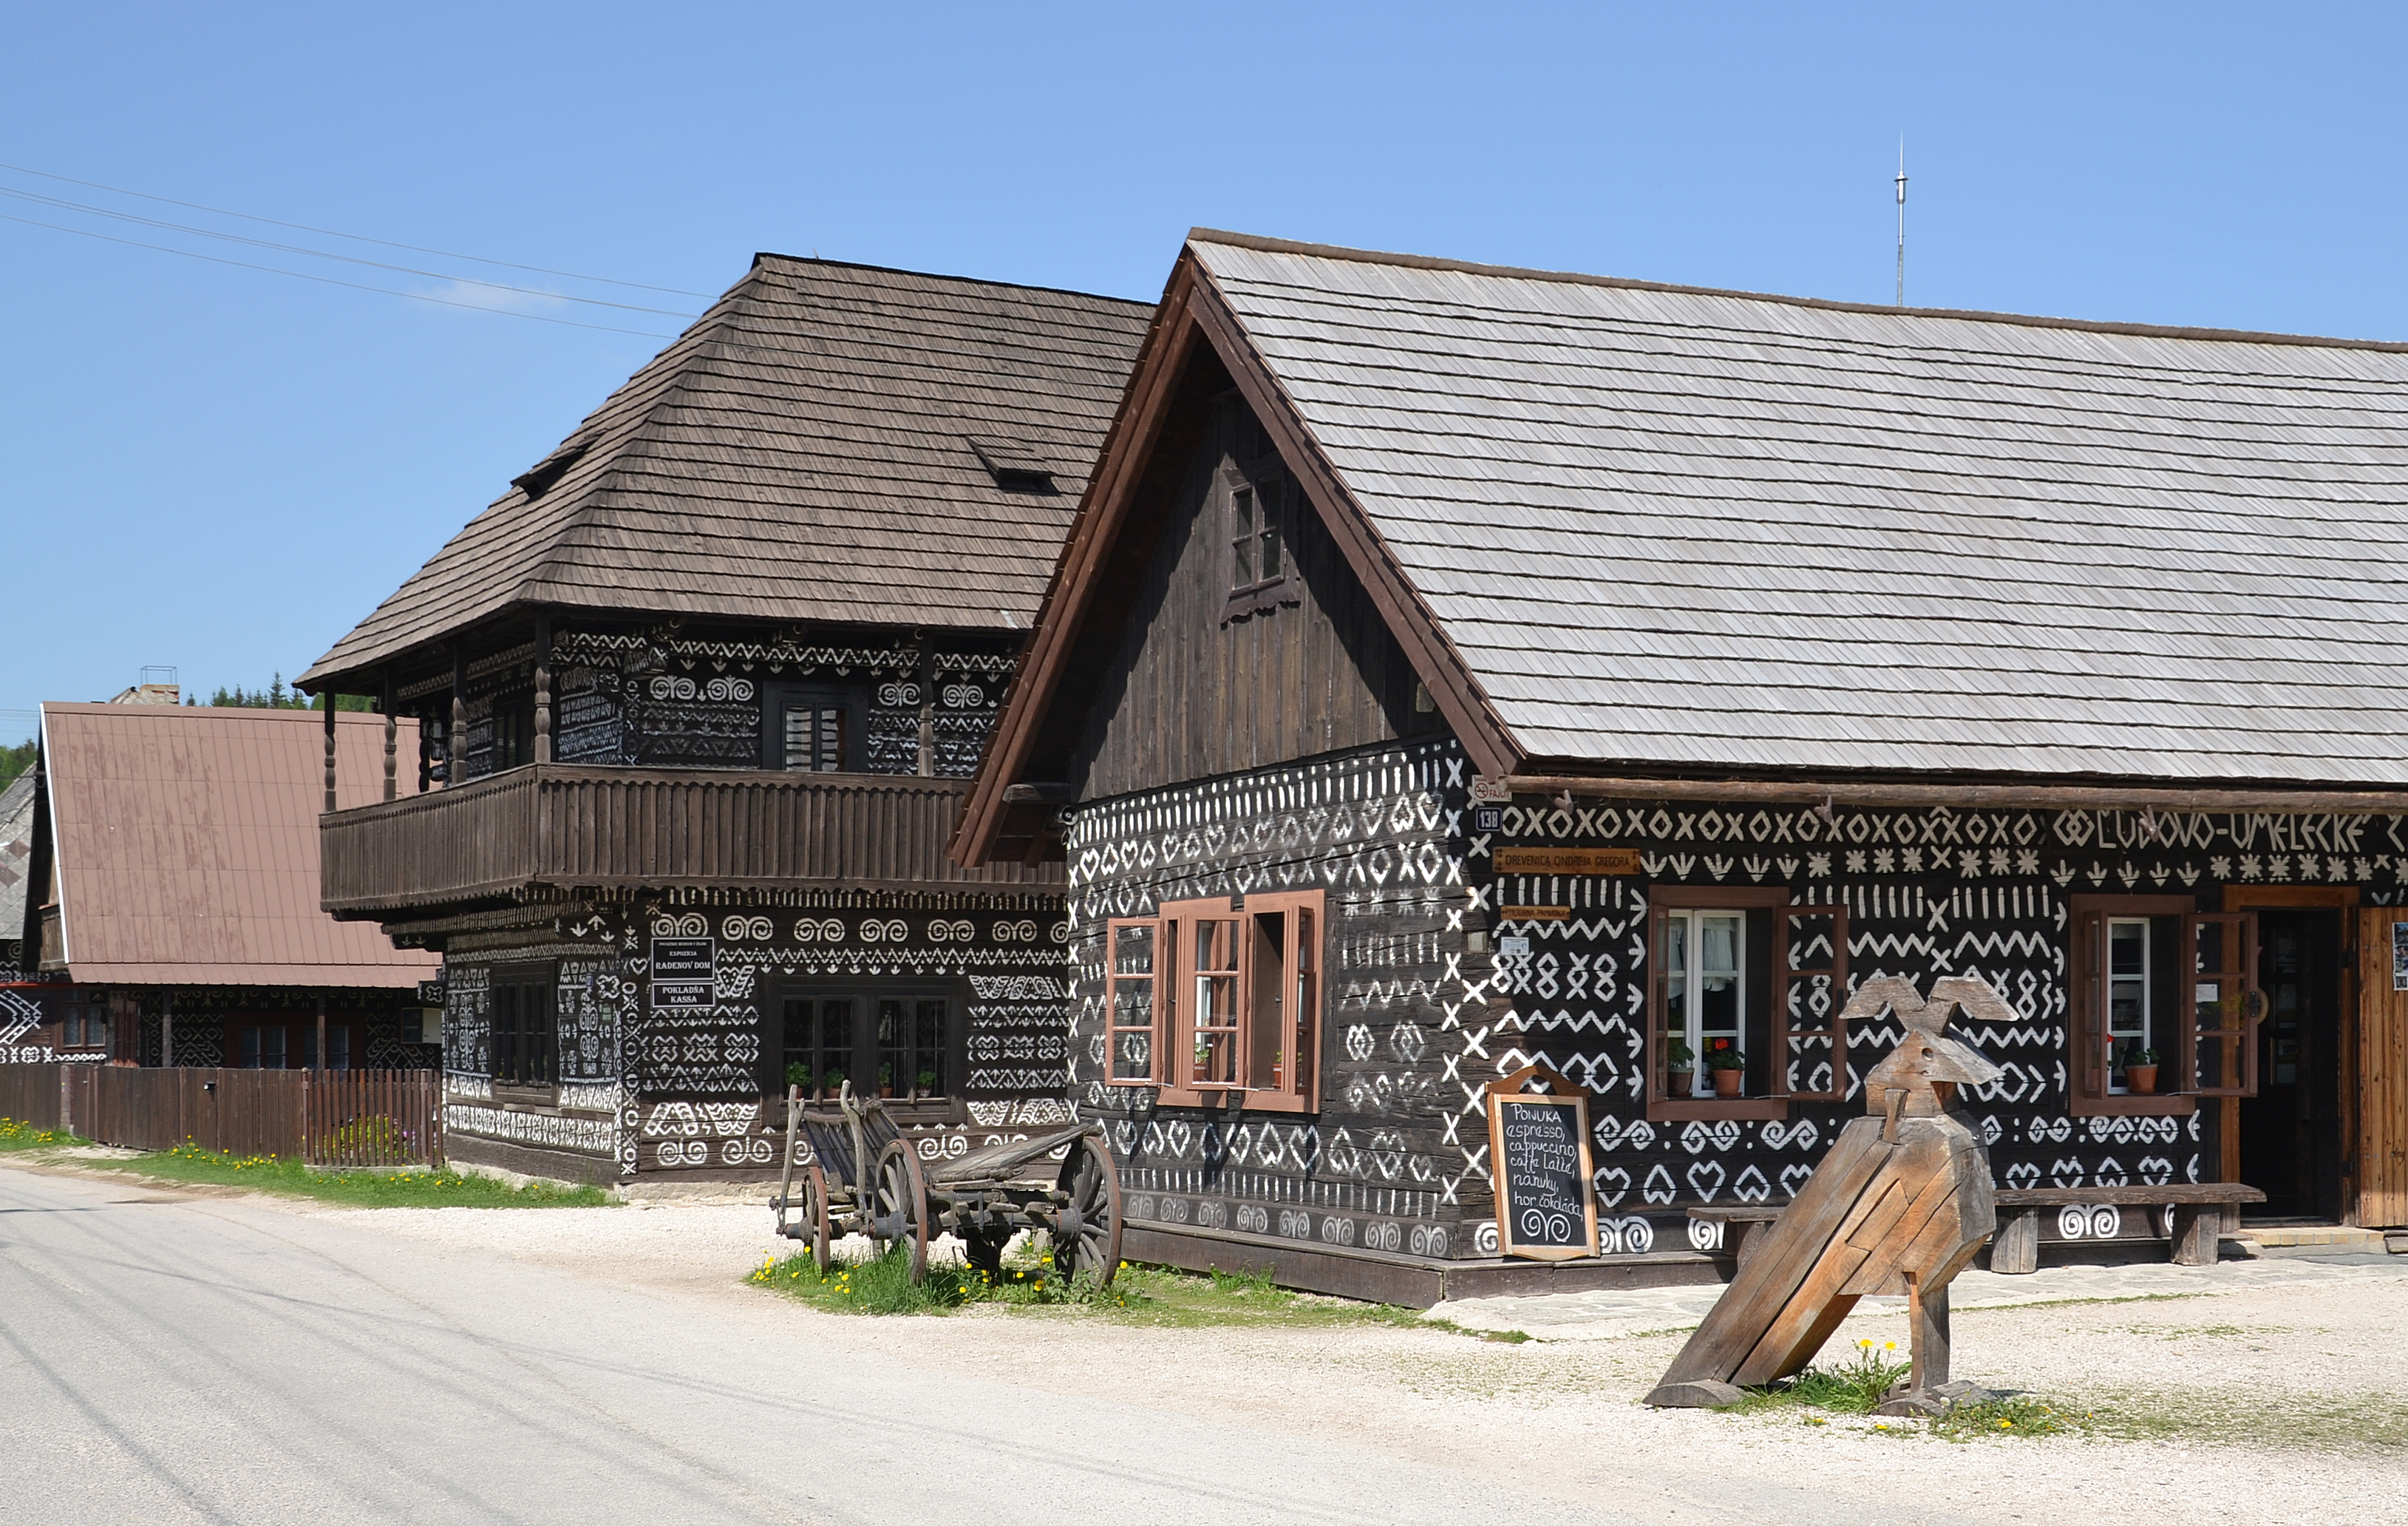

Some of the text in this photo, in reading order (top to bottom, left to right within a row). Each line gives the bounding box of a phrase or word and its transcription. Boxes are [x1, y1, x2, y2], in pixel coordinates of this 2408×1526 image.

[1480, 811, 1498, 827] 138
[1505, 855, 1630, 868] DREVENICA ONDREJA GREGORA
[656, 960, 711, 969] RADENOV DOM
